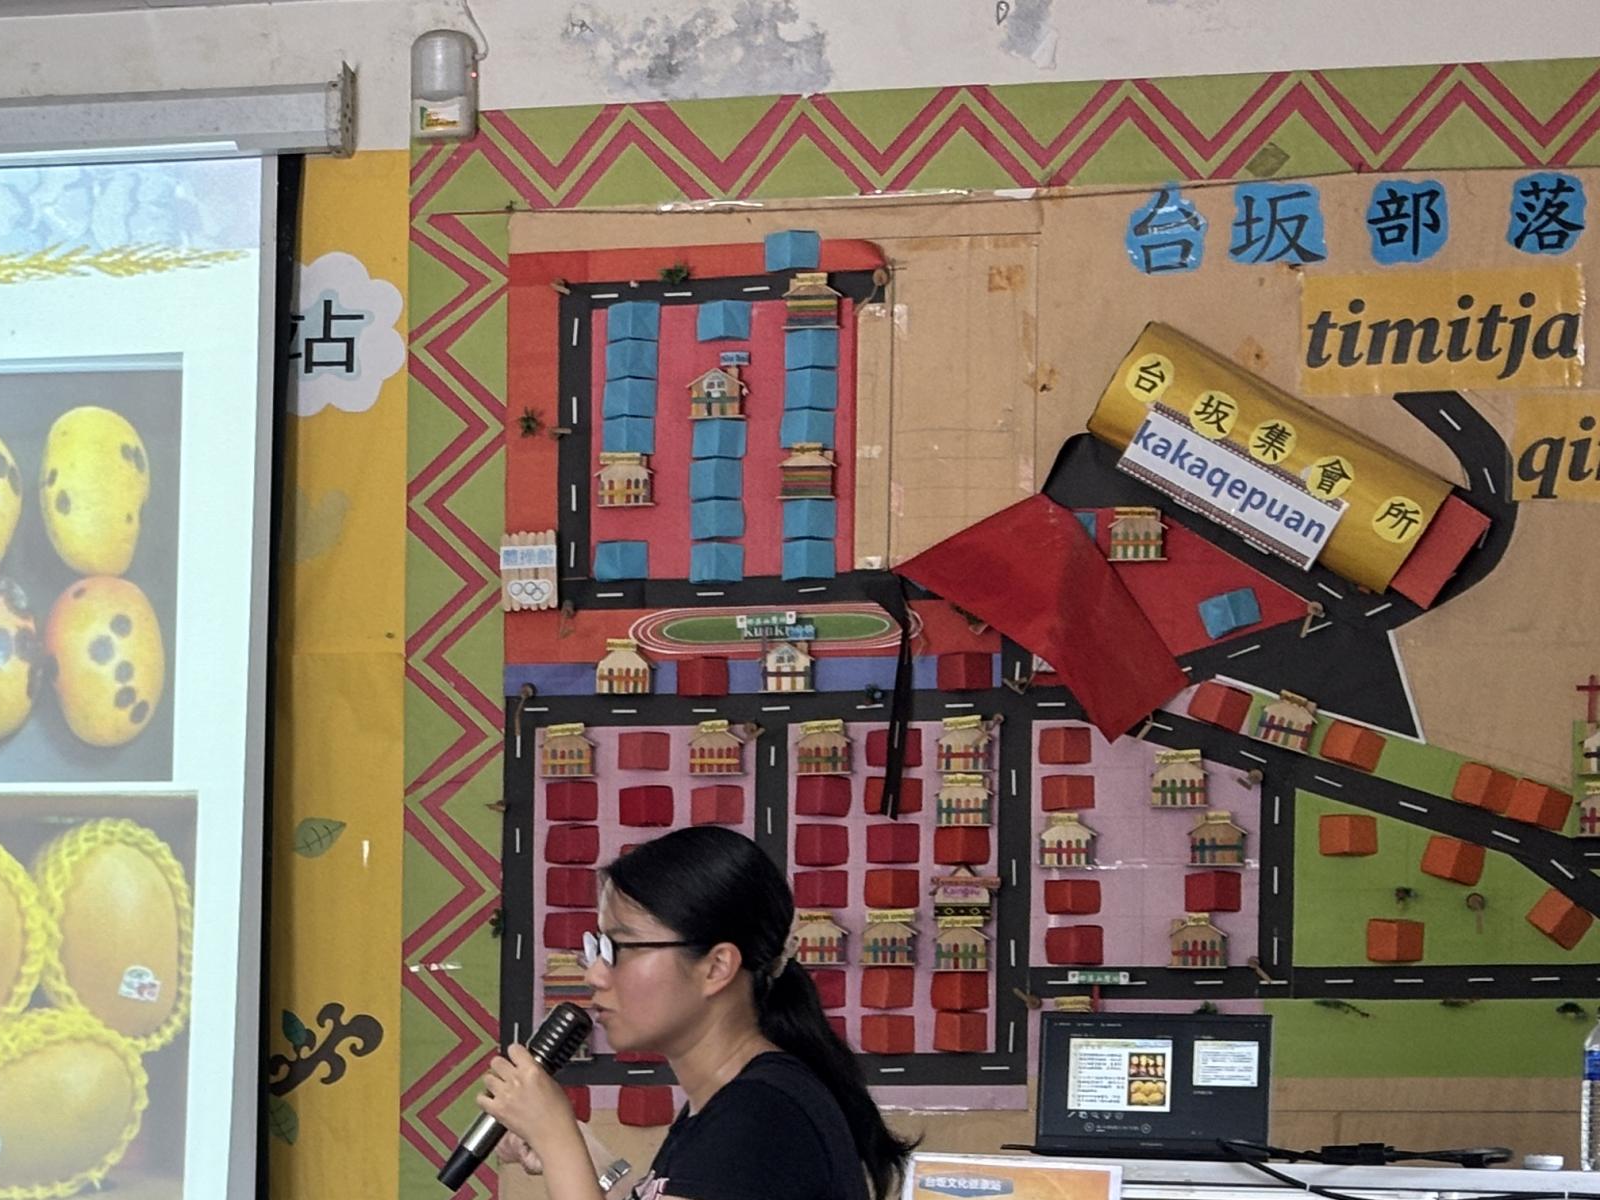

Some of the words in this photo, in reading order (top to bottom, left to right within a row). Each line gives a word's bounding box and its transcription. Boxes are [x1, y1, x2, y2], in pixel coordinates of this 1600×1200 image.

[1133, 177, 1586, 275] 台坂部落
[1307, 291, 1581, 380] timitja
[1133, 359, 1423, 541] 台坂集會所
[1133, 420, 1328, 546] kakaqepuan
[1517, 416, 1600, 499] qi
